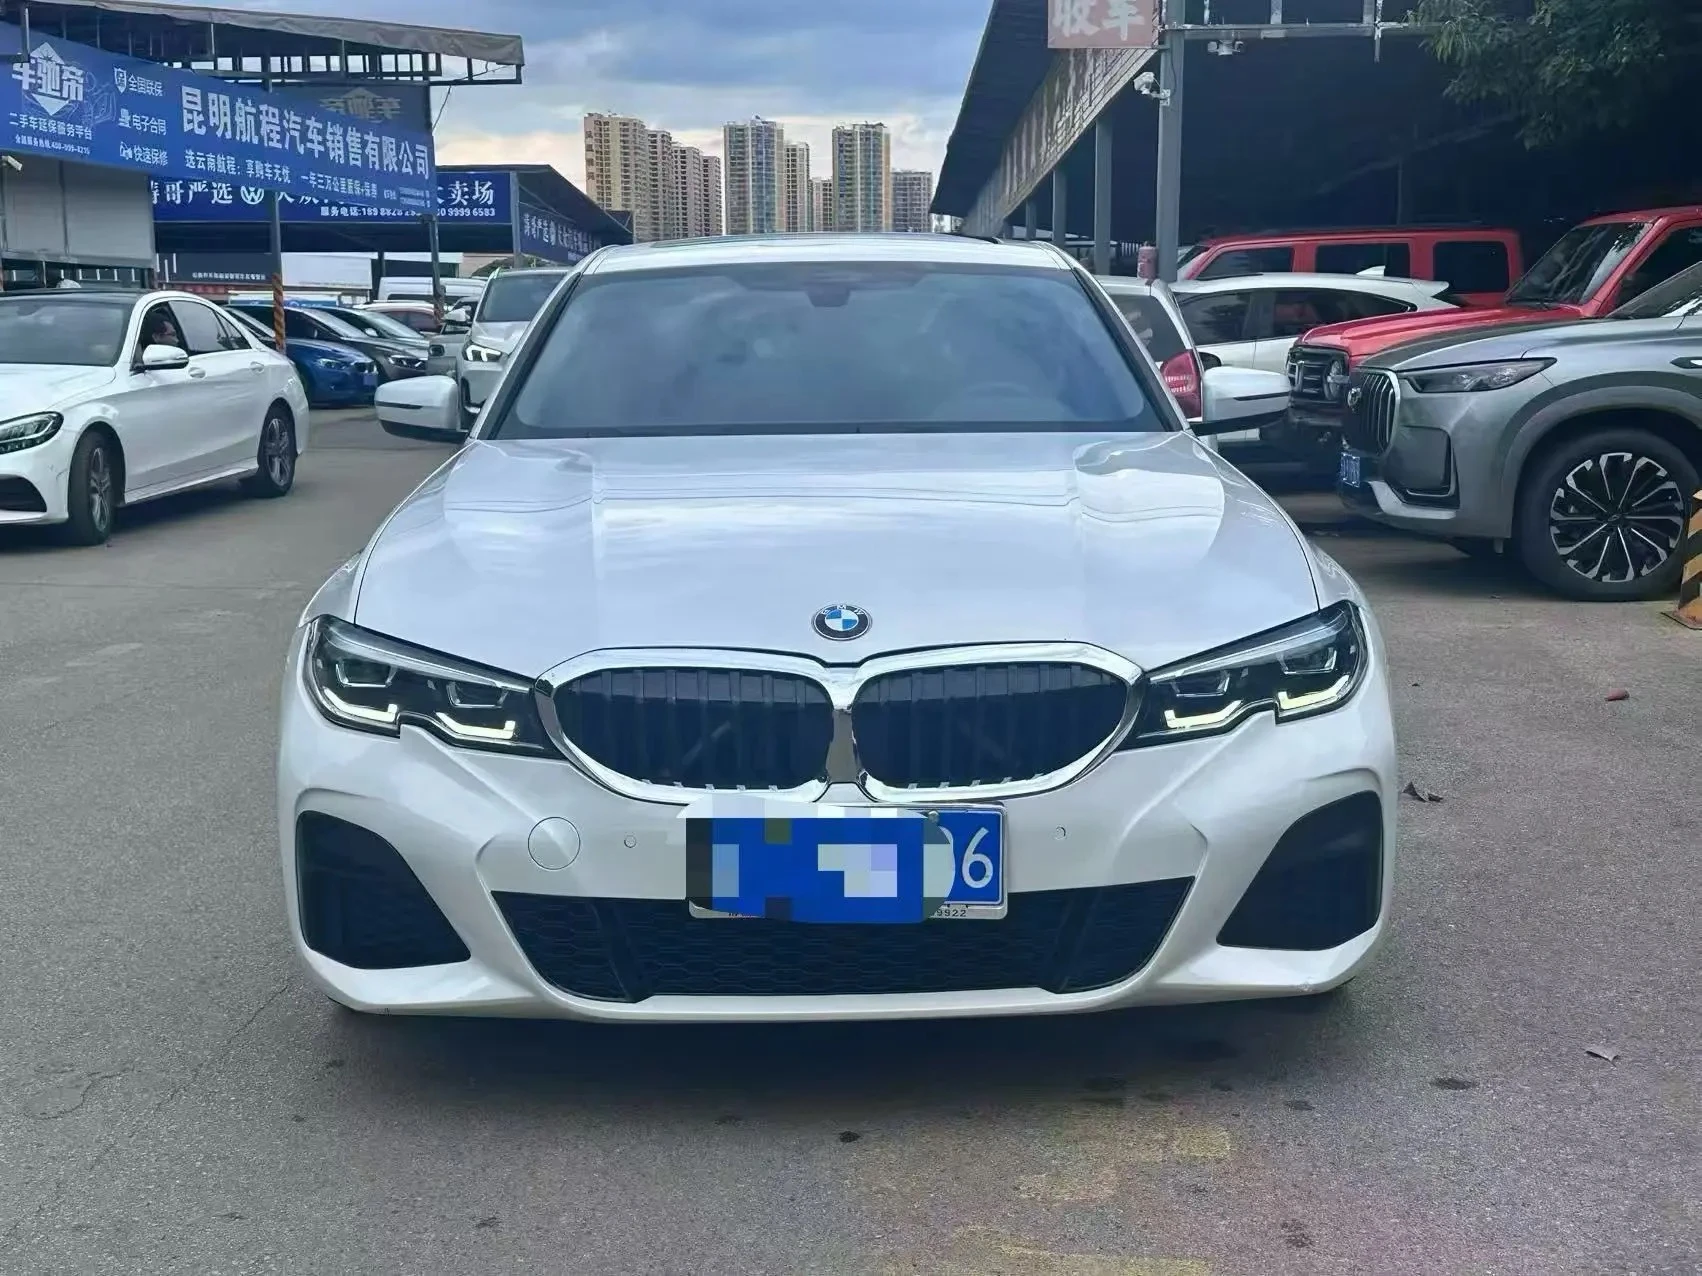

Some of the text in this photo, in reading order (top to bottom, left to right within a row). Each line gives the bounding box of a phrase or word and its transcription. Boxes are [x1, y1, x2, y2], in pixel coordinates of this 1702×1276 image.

[132, 114, 167, 136] 电子合同
[181, 85, 429, 180] 昆明航程汽车销售有限公司
